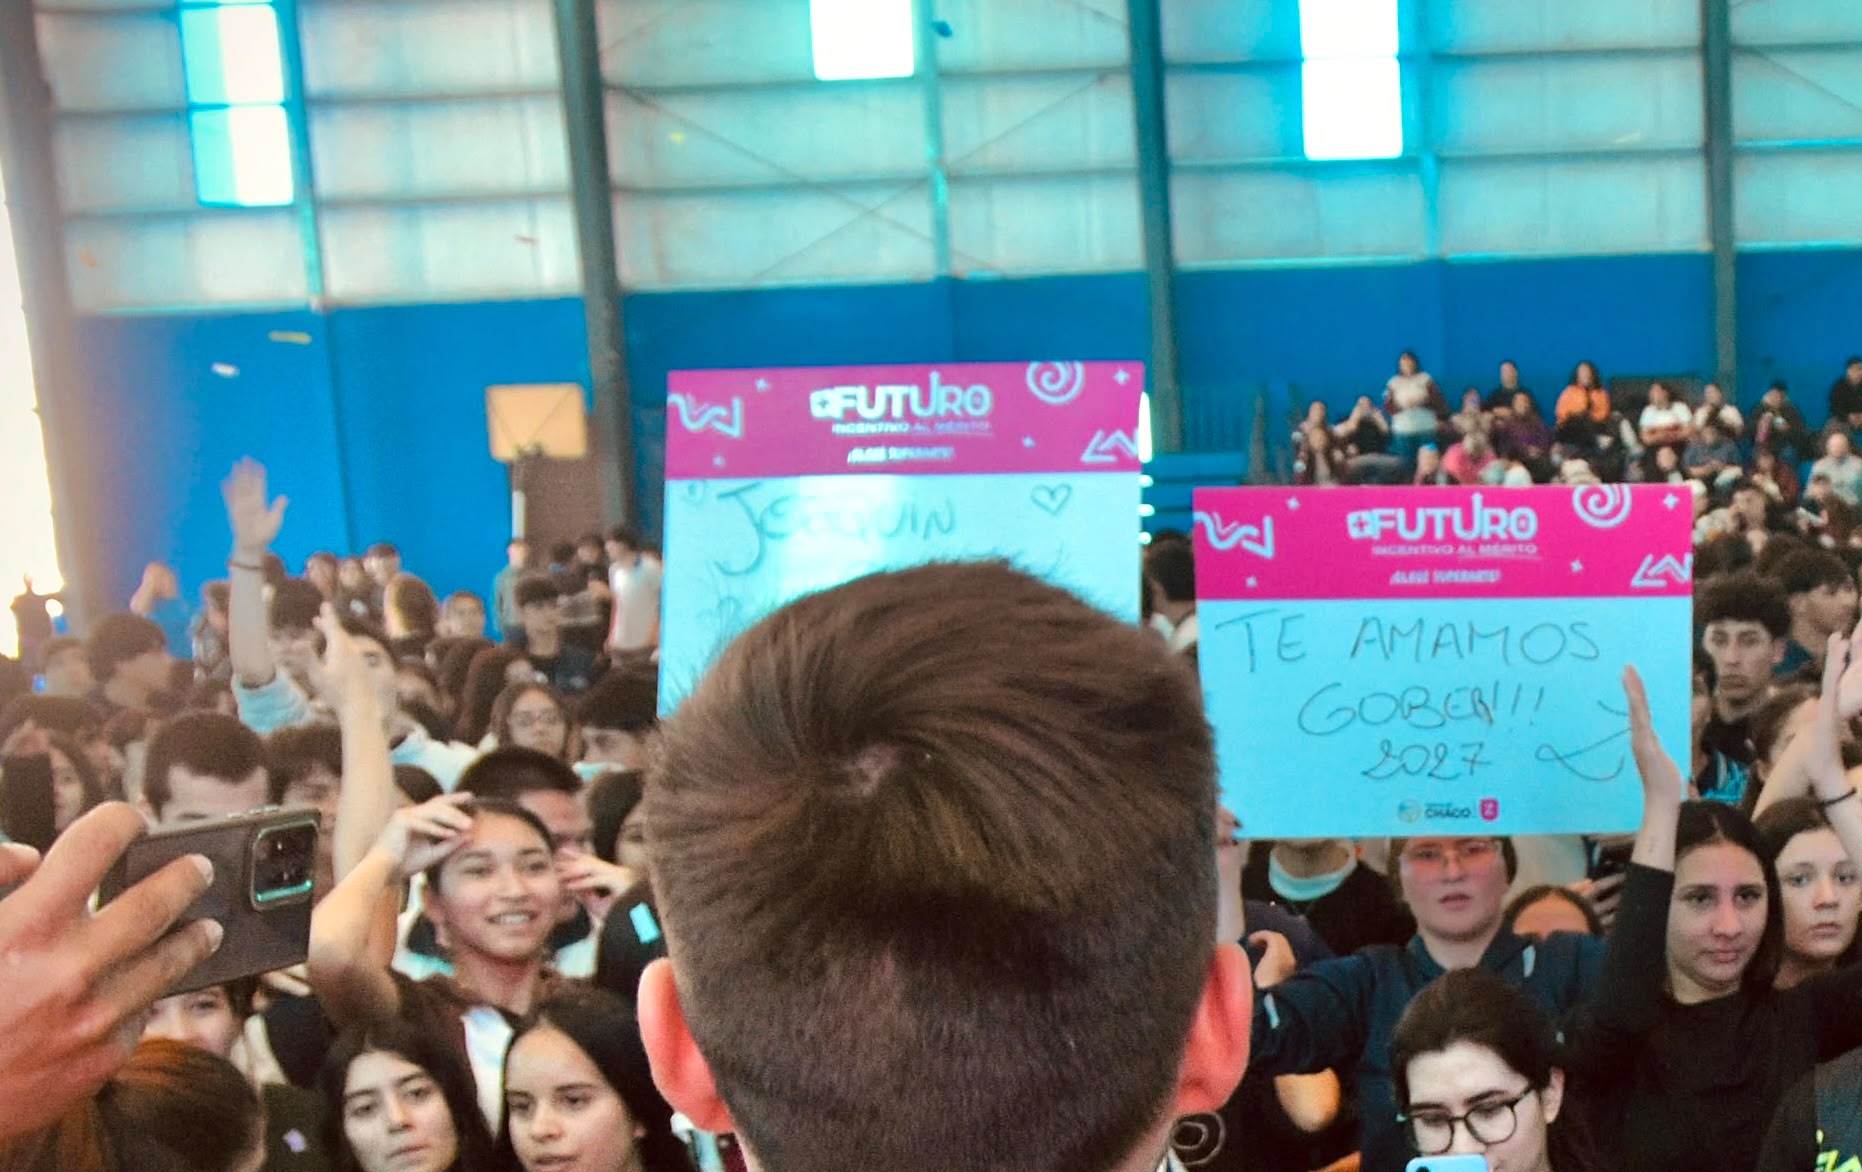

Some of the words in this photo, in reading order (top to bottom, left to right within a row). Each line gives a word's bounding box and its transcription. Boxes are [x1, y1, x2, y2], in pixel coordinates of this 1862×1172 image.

[831, 371, 993, 420] FUTURO
[1371, 492, 1539, 541] FUTURO
[1215, 608, 1308, 673] TE
[1349, 616, 1600, 664] AMAMOS
[1361, 738, 1491, 781] 2027
